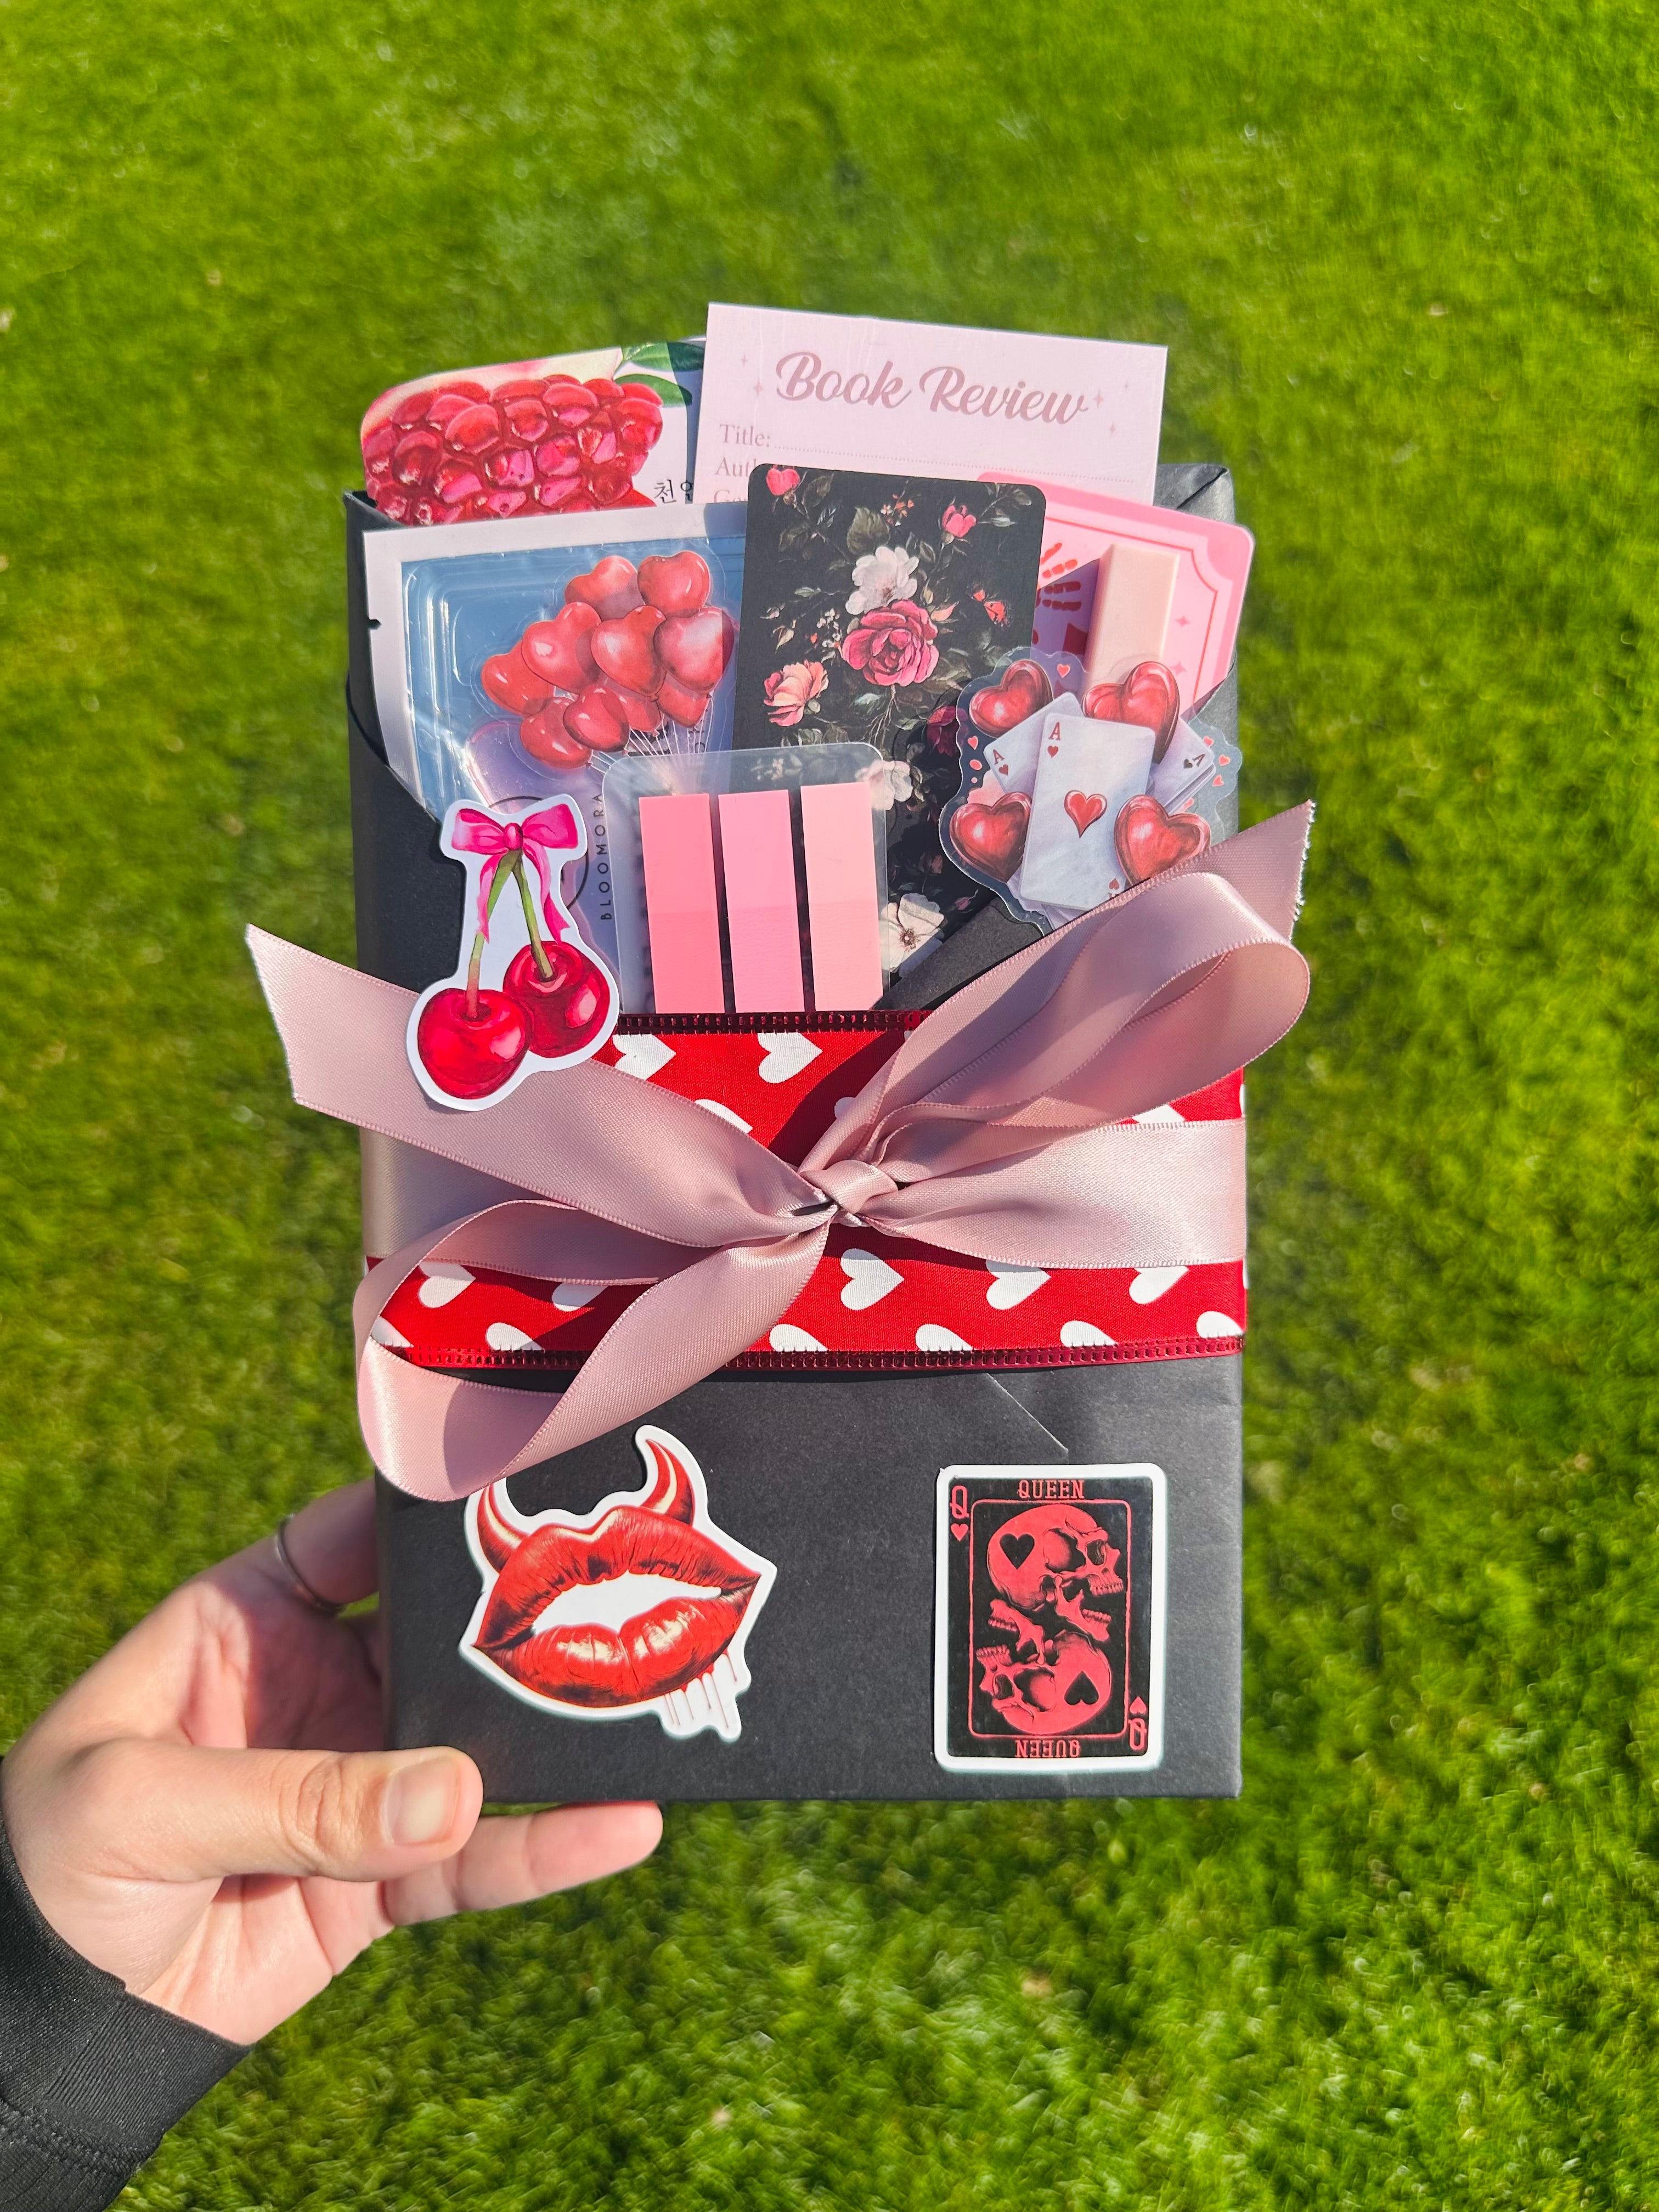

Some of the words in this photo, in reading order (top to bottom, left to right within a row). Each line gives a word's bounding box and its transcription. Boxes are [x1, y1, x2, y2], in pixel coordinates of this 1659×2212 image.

[775, 351, 912, 409] Book
[919, 366, 1089, 425] Review
[719, 423, 771, 448] Title:
[1048, 721, 1061, 741] A
[992, 749, 1005, 765] A
[592, 793, 612, 921] BLOOMORA
[949, 1485, 969, 1519] Q
[1017, 1480, 1085, 1499] QUEEN
[1127, 1718, 1147, 1751] Q
[1014, 1739, 1081, 1758] QUEEN
